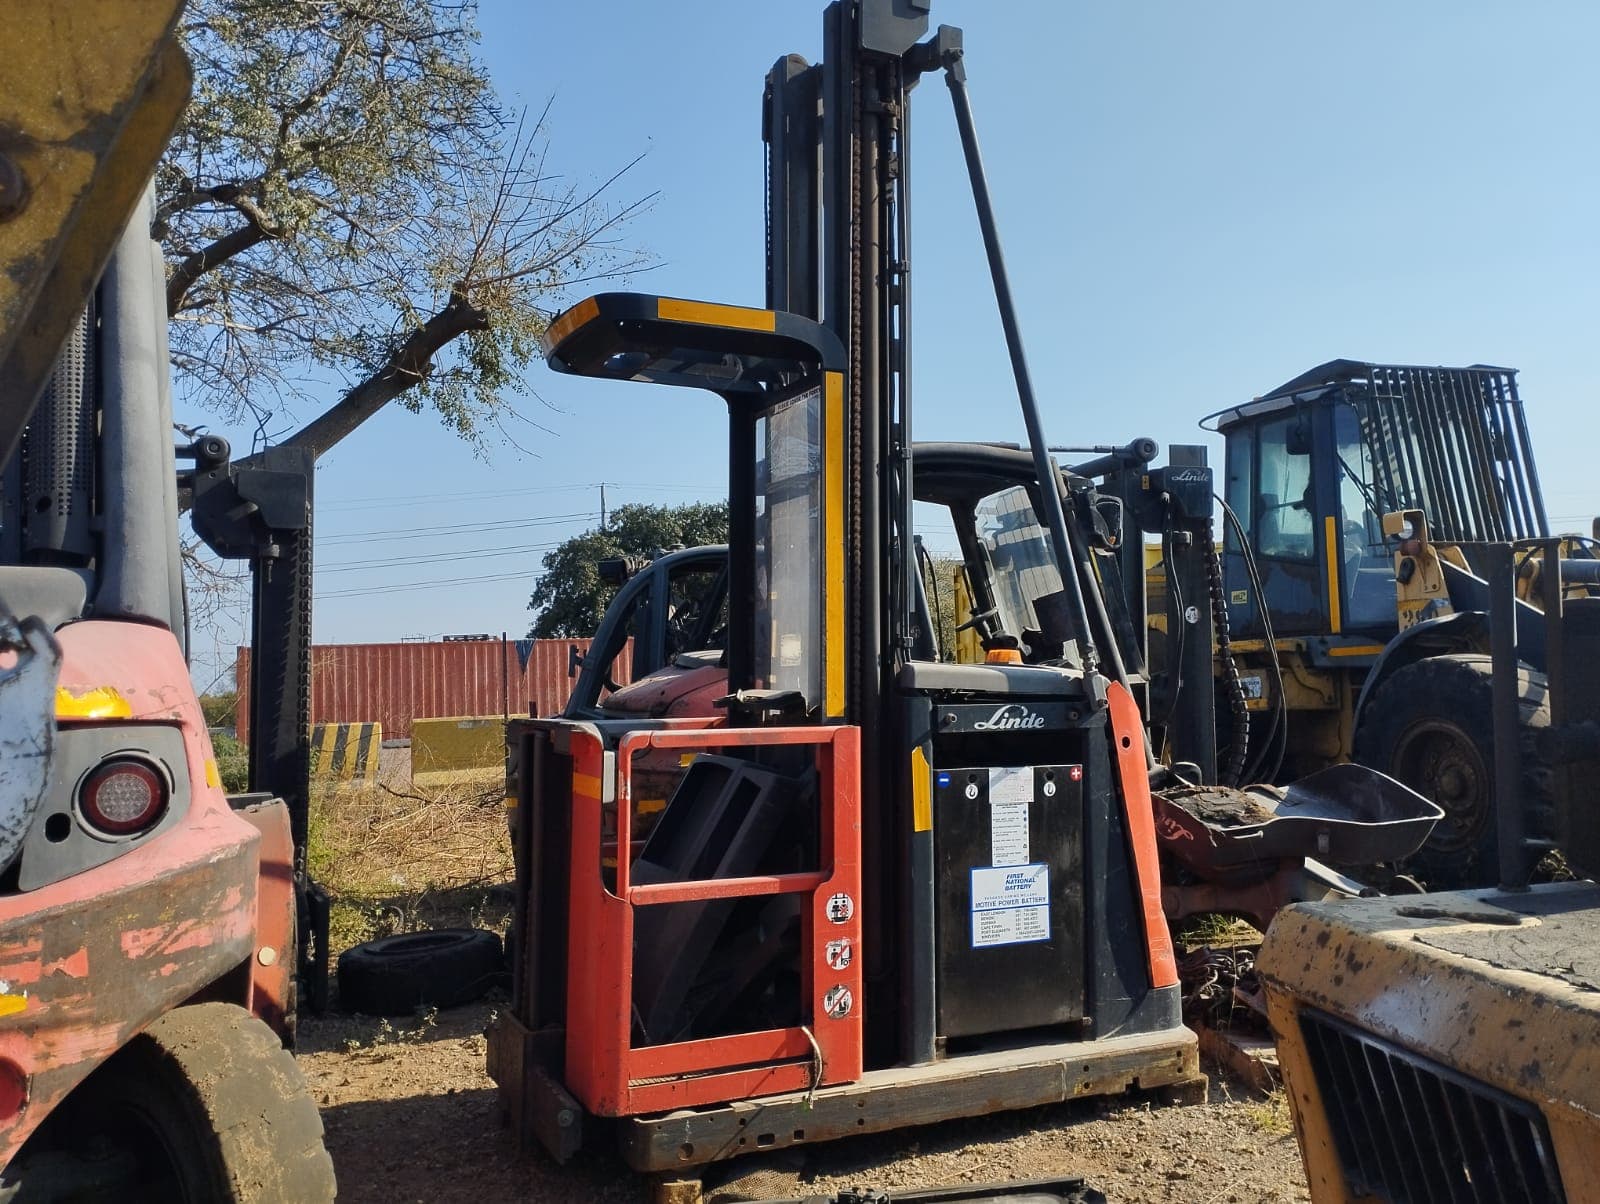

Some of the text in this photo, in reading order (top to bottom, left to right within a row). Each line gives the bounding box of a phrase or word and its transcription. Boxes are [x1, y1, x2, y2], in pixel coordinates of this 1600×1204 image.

[1171, 469, 1208, 481] Linde
[974, 704, 1045, 730] Linde
[1005, 877, 1036, 885] NATIONAL
[1004, 883, 1032, 891] BATTERY
[975, 900, 997, 908] MOTIVE
